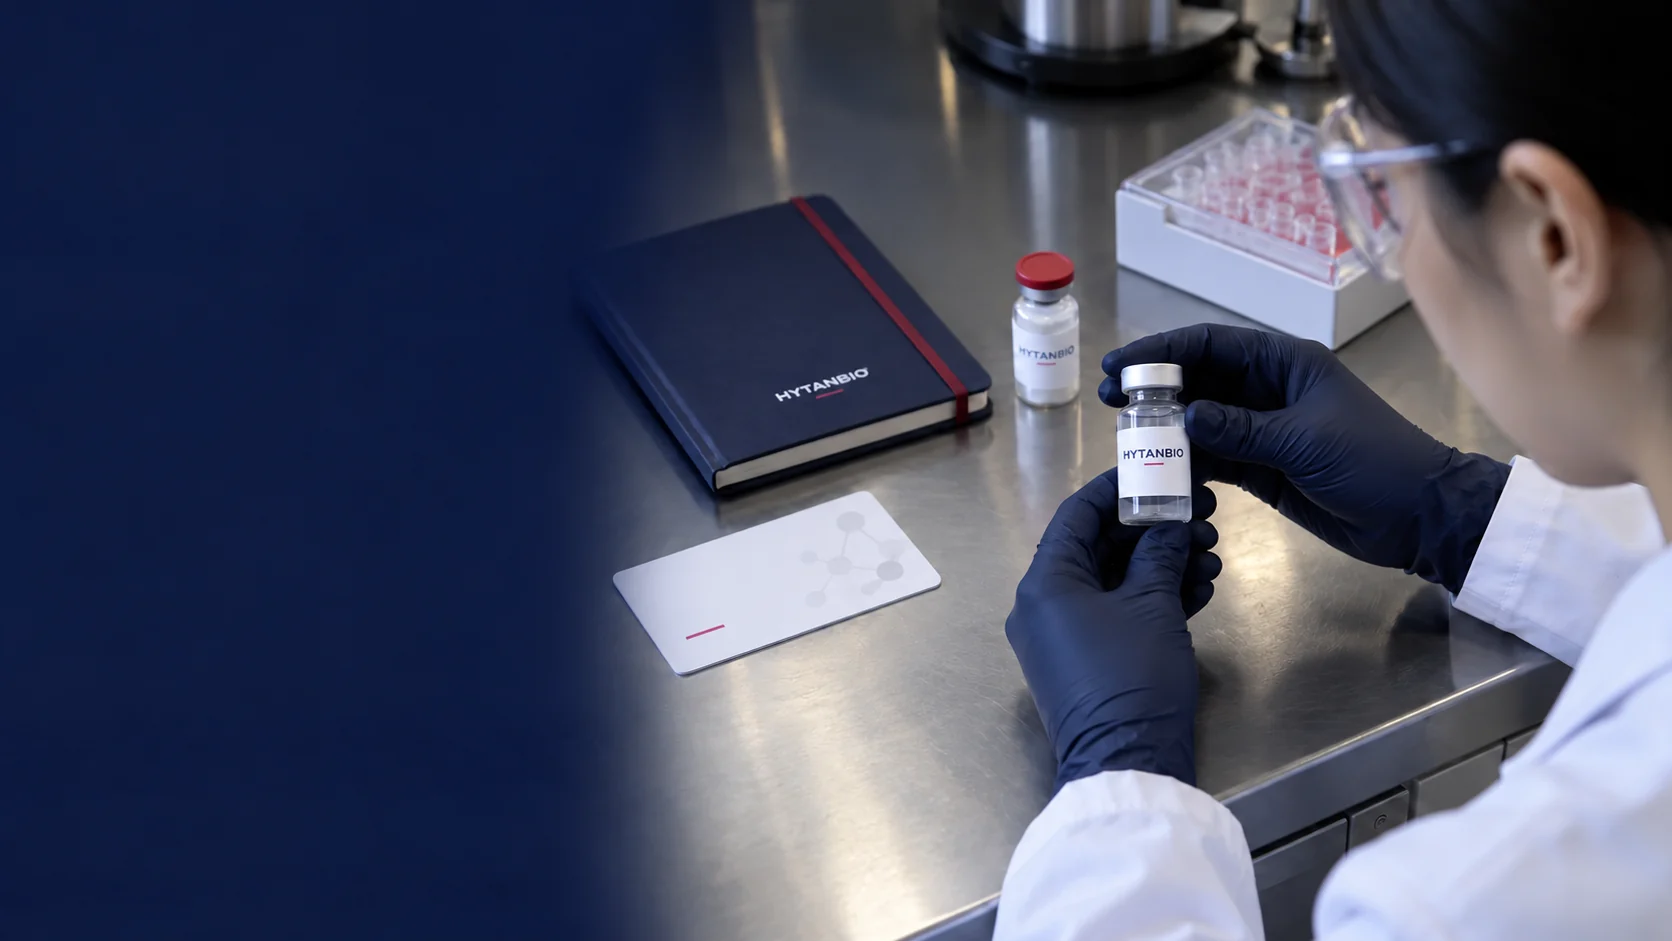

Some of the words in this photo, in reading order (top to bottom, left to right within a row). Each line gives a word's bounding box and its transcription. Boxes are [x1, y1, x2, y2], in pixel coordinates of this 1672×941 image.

[1019, 345, 1075, 360] HYTANBIO
[775, 367, 869, 402] HYTANBIO
[1123, 448, 1184, 460] HYTANBIO
